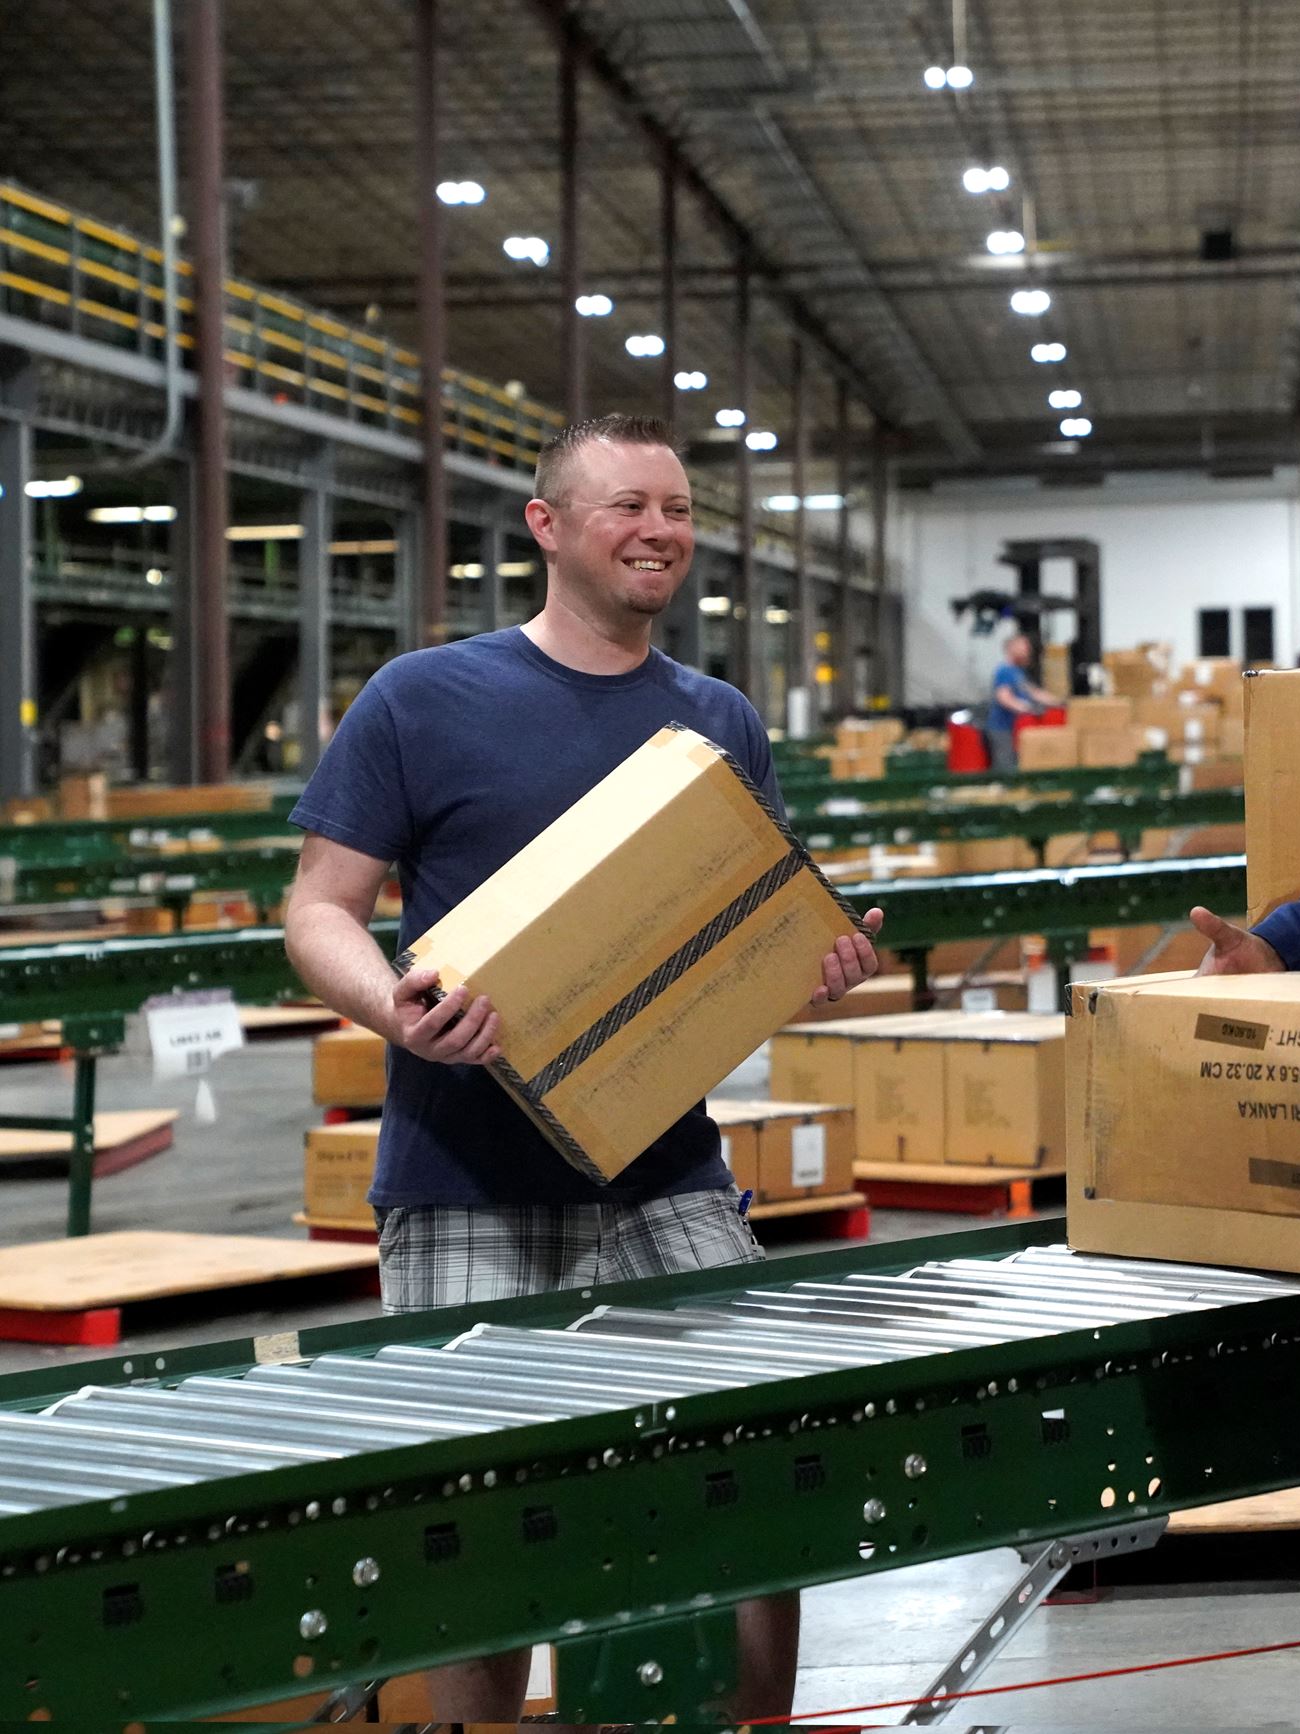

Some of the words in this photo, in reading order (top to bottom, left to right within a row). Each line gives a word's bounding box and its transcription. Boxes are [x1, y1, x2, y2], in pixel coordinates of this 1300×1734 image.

[1200, 1061, 1223, 1078] CM
[1226, 1063, 1262, 1080] 20.32
[1266, 1065, 1276, 1082] X
[1238, 1101, 1287, 1121] LANKA
